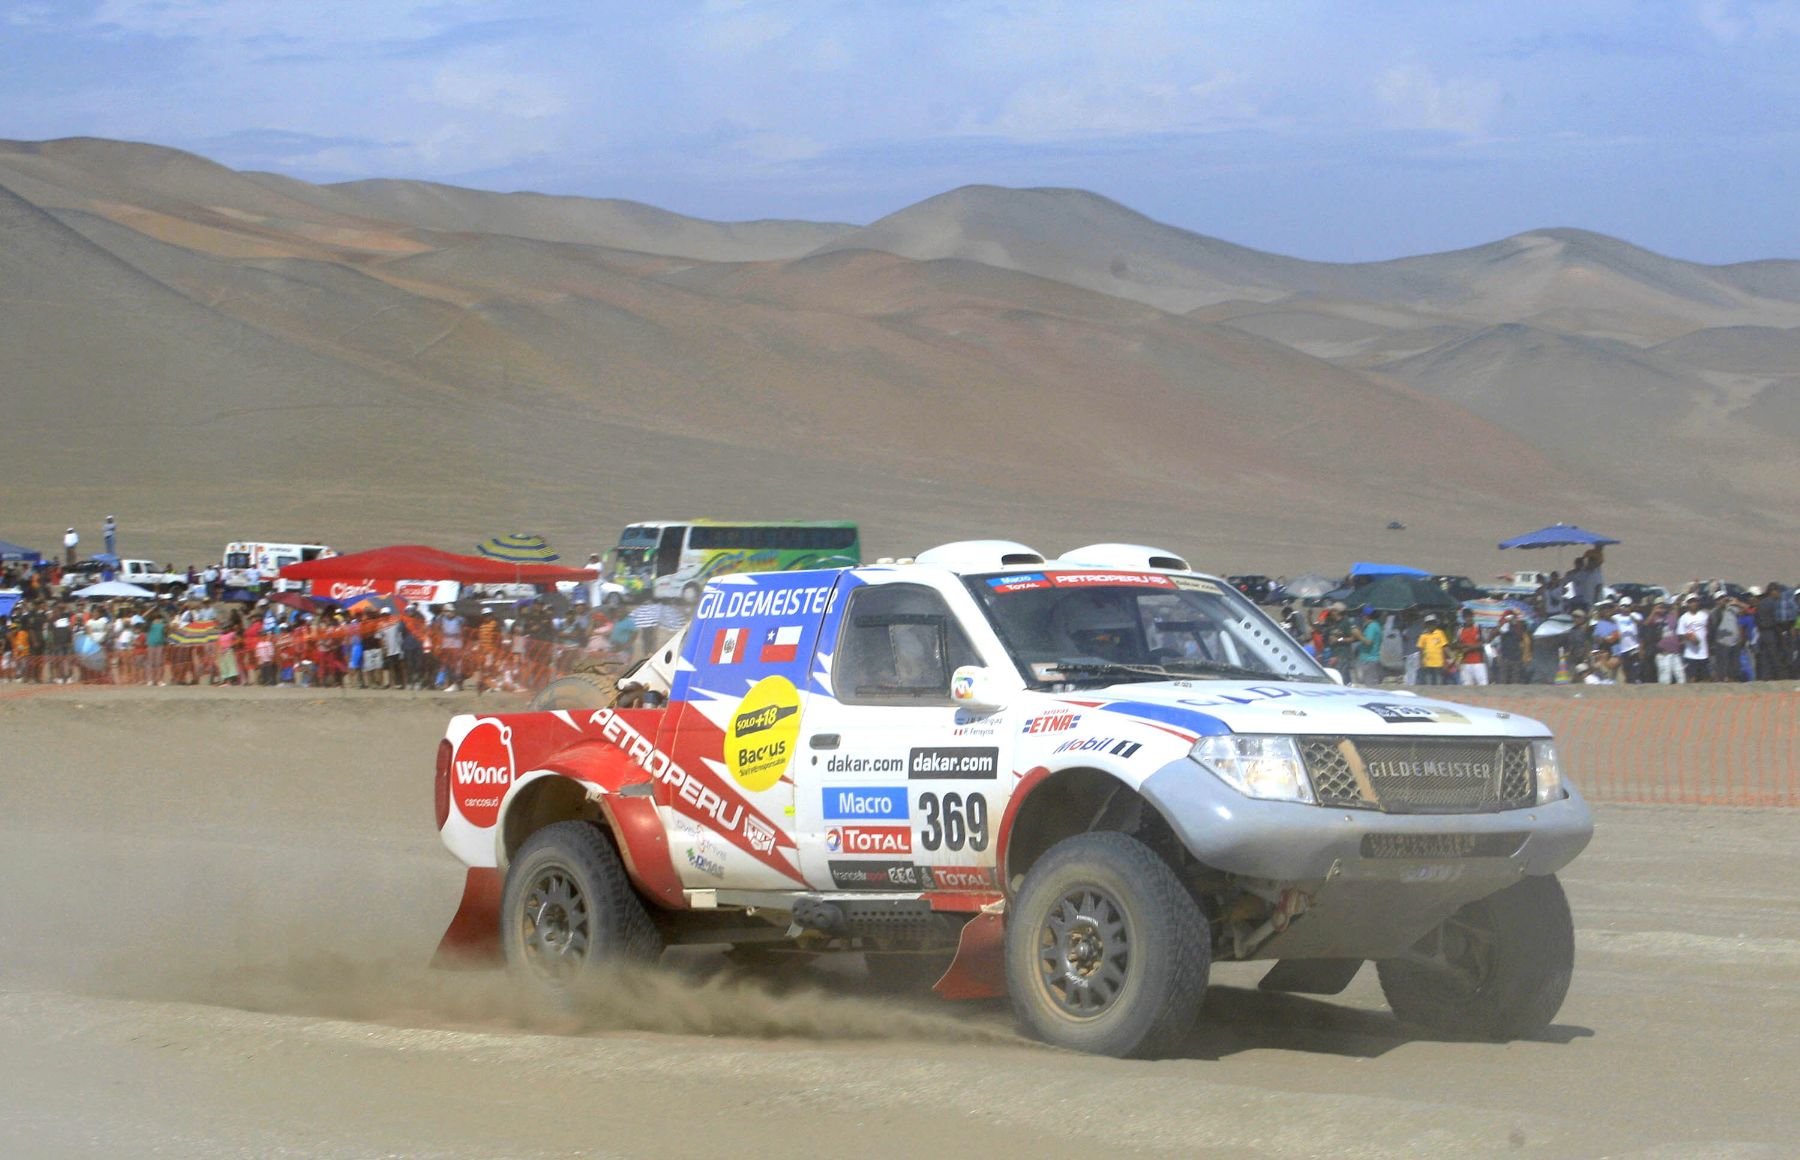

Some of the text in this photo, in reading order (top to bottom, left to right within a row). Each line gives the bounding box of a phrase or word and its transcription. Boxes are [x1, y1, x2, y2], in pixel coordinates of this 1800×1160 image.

[1056, 575, 1149, 584] PETROPERU
[697, 586, 839, 619] GILDEMEISTER
[737, 706, 778, 731] SOLO +18
[1029, 714, 1075, 734] ETNA
[1052, 737, 1115, 755] Mobil
[589, 708, 744, 830] PETROPERU
[827, 754, 903, 772] dakar.com
[913, 752, 993, 772] dakar.com
[1369, 761, 1491, 779] GILDEMEISTER
[456, 761, 508, 785] Wong
[839, 792, 892, 814] Macro
[919, 792, 989, 852] 369
[845, 829, 909, 850] TOTAL
[935, 870, 990, 887] TOTAL
